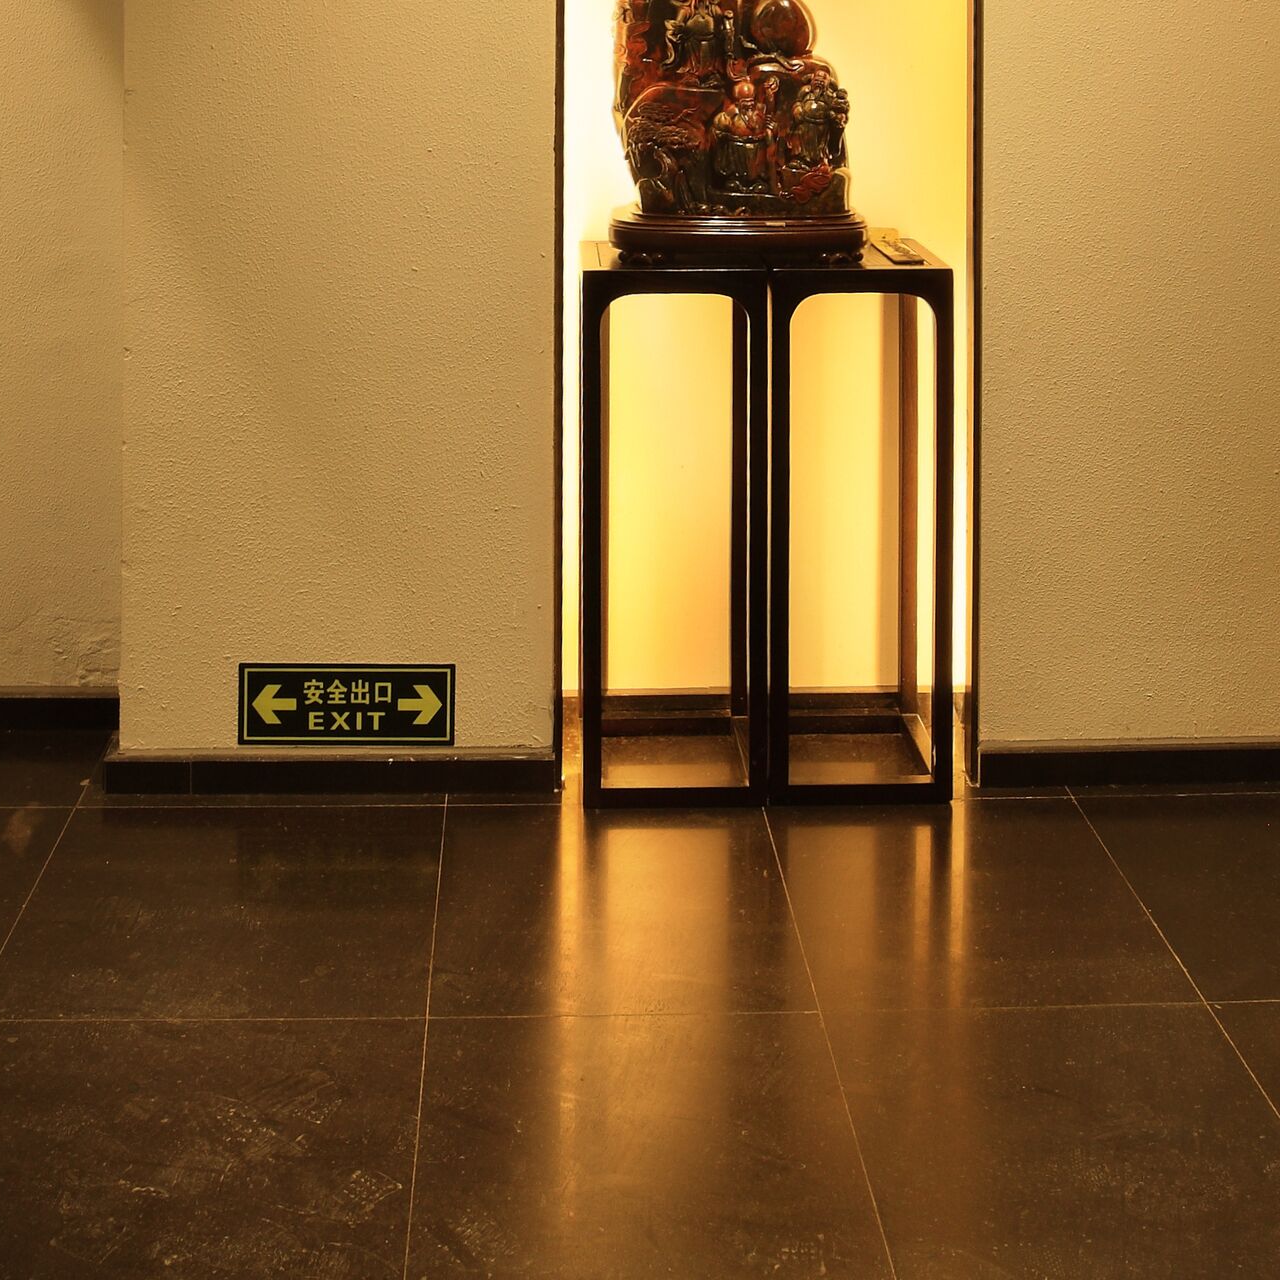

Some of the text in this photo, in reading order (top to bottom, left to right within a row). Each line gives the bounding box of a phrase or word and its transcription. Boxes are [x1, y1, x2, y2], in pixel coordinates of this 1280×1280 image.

[303, 679, 393, 705] 安全出口
[308, 711, 386, 731] EXIT
